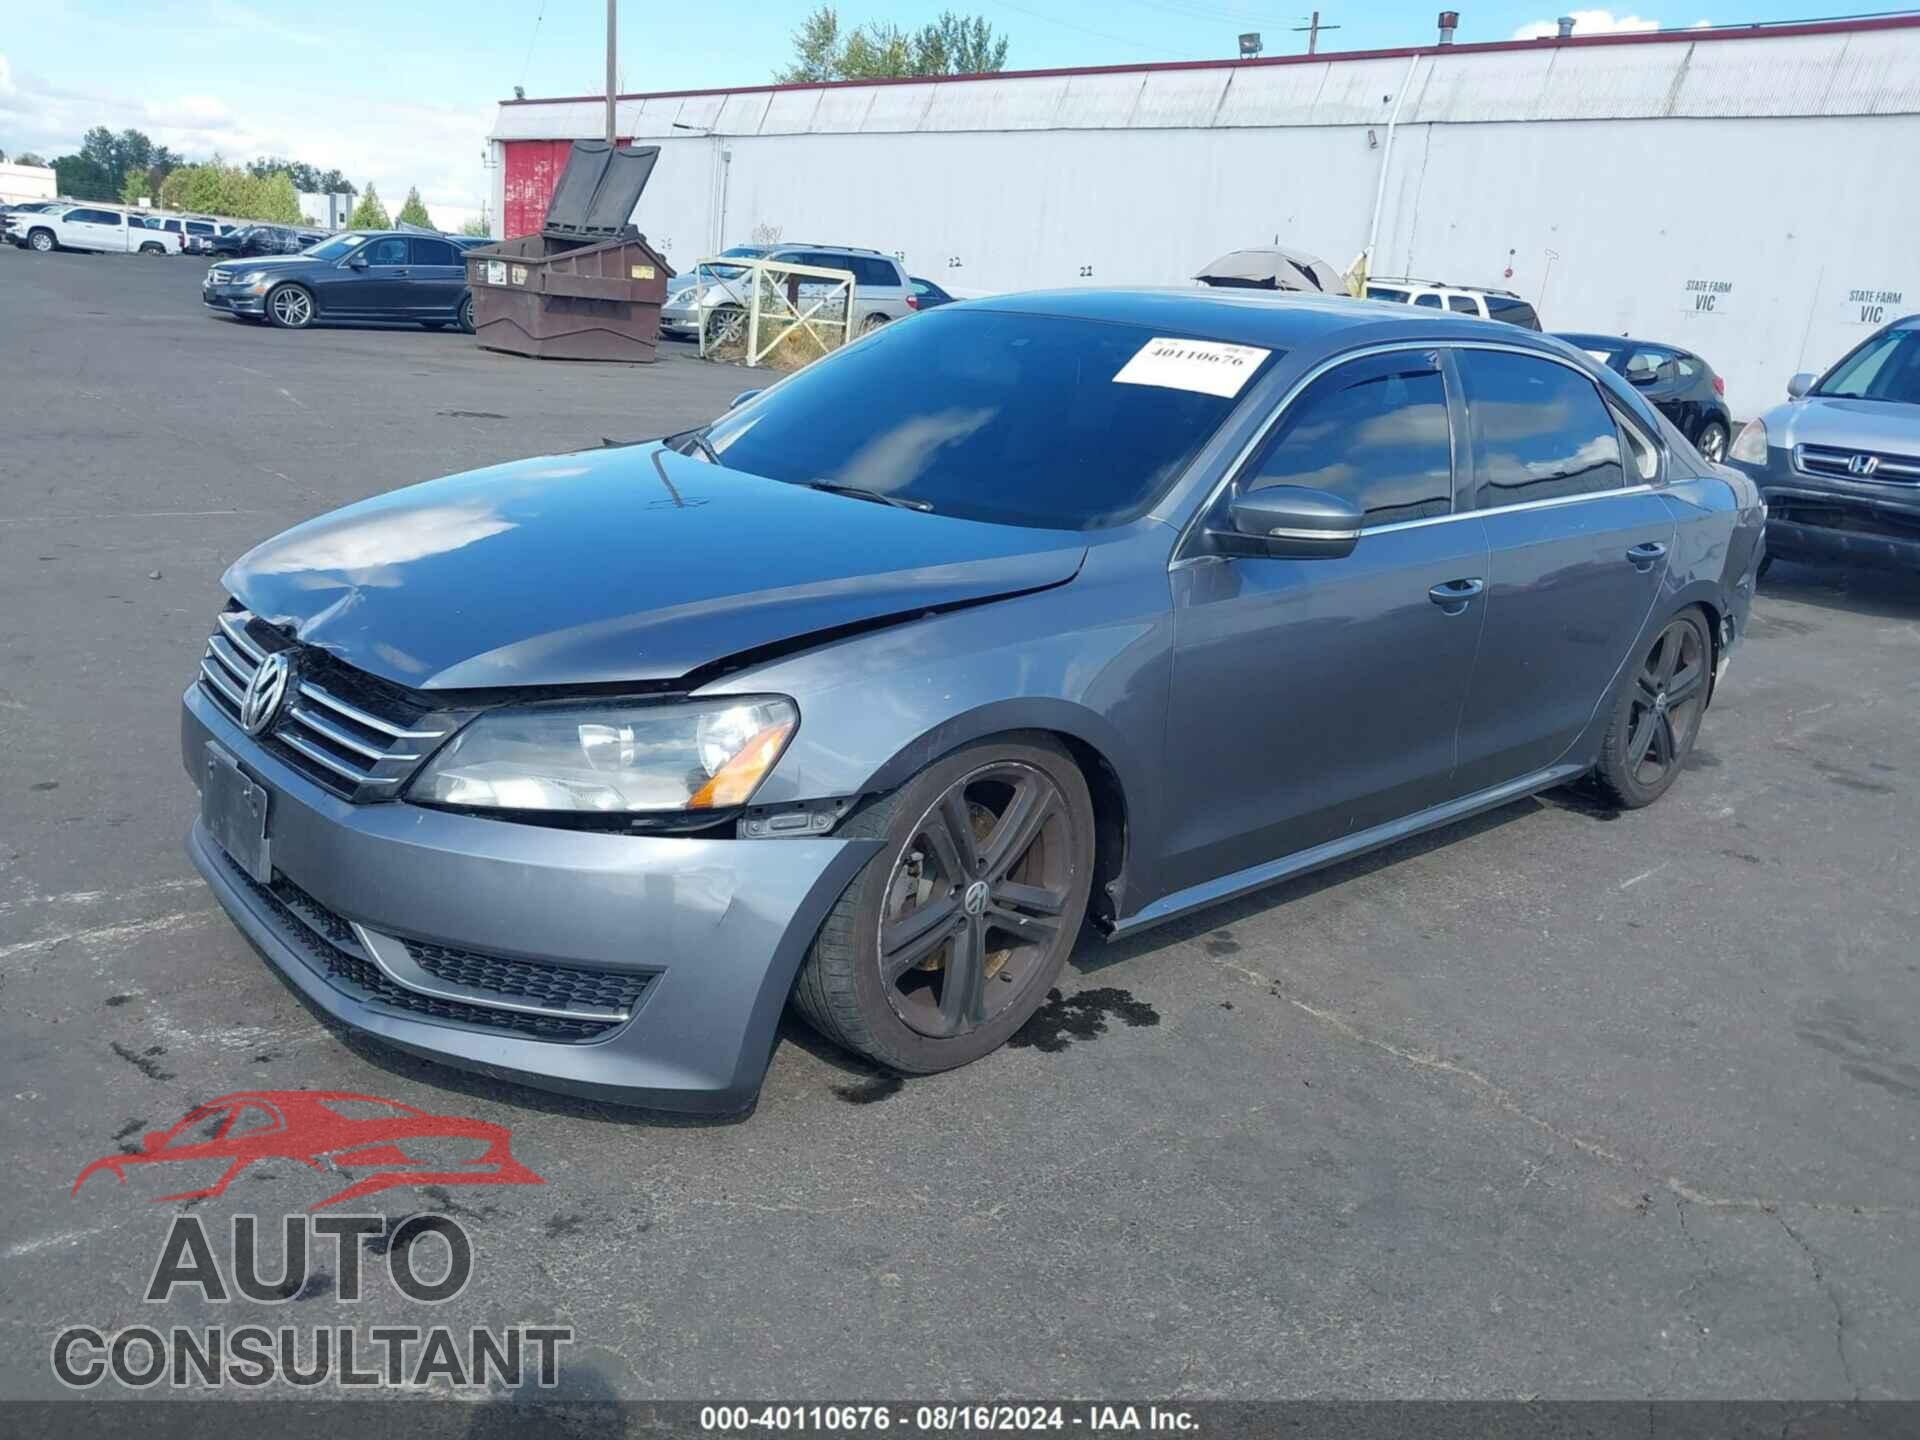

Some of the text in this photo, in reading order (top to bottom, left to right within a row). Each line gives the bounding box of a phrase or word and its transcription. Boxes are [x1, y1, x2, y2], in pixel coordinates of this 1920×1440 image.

[948, 256, 963, 268] 22
[1079, 265, 1093, 277] 21
[1685, 280, 1733, 293] STATE FARM
[1695, 294, 1716, 312] VIC
[1849, 290, 1902, 304] STATE FARM
[1860, 305, 1884, 323] VIC
[1152, 347, 1244, 366] 40110676
